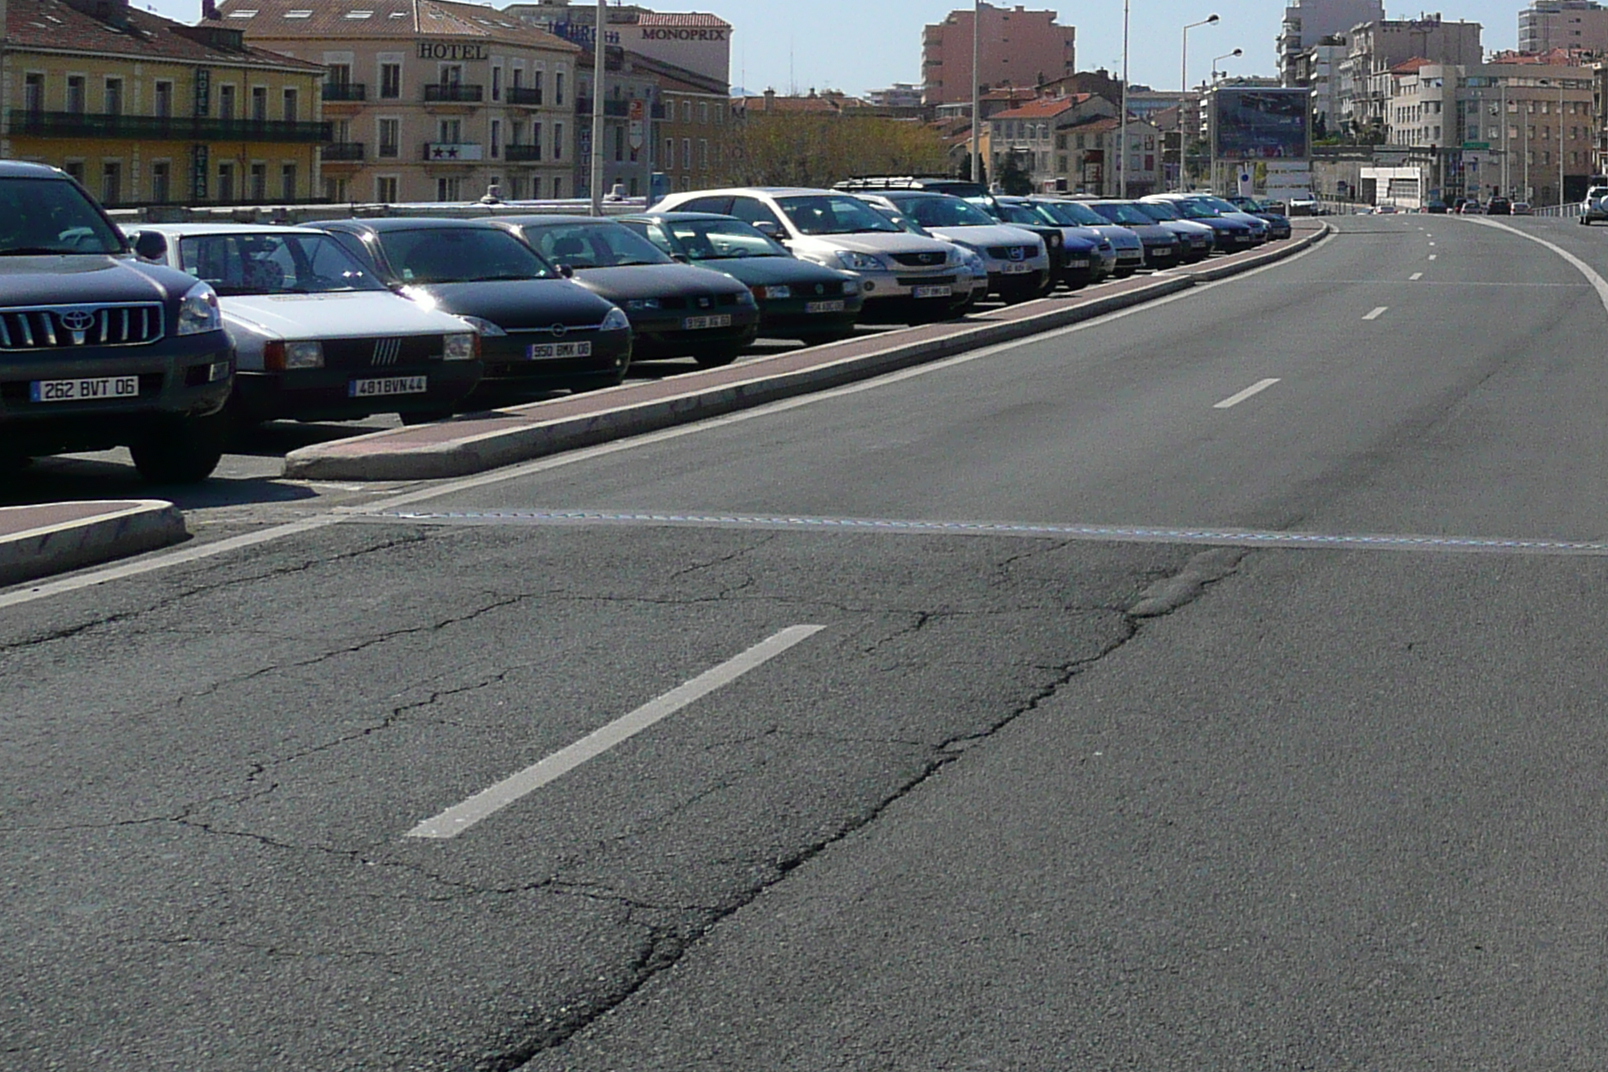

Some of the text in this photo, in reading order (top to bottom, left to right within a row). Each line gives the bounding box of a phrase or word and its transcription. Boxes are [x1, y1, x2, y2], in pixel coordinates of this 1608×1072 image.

[641, 28, 726, 42] MONOPRIX
[419, 43, 488, 60] HOTEL
[196, 70, 208, 198] HOTEL ATLAS
[581, 130, 591, 188] HOTEL
[44, 378, 135, 399] 262 BVT 06
